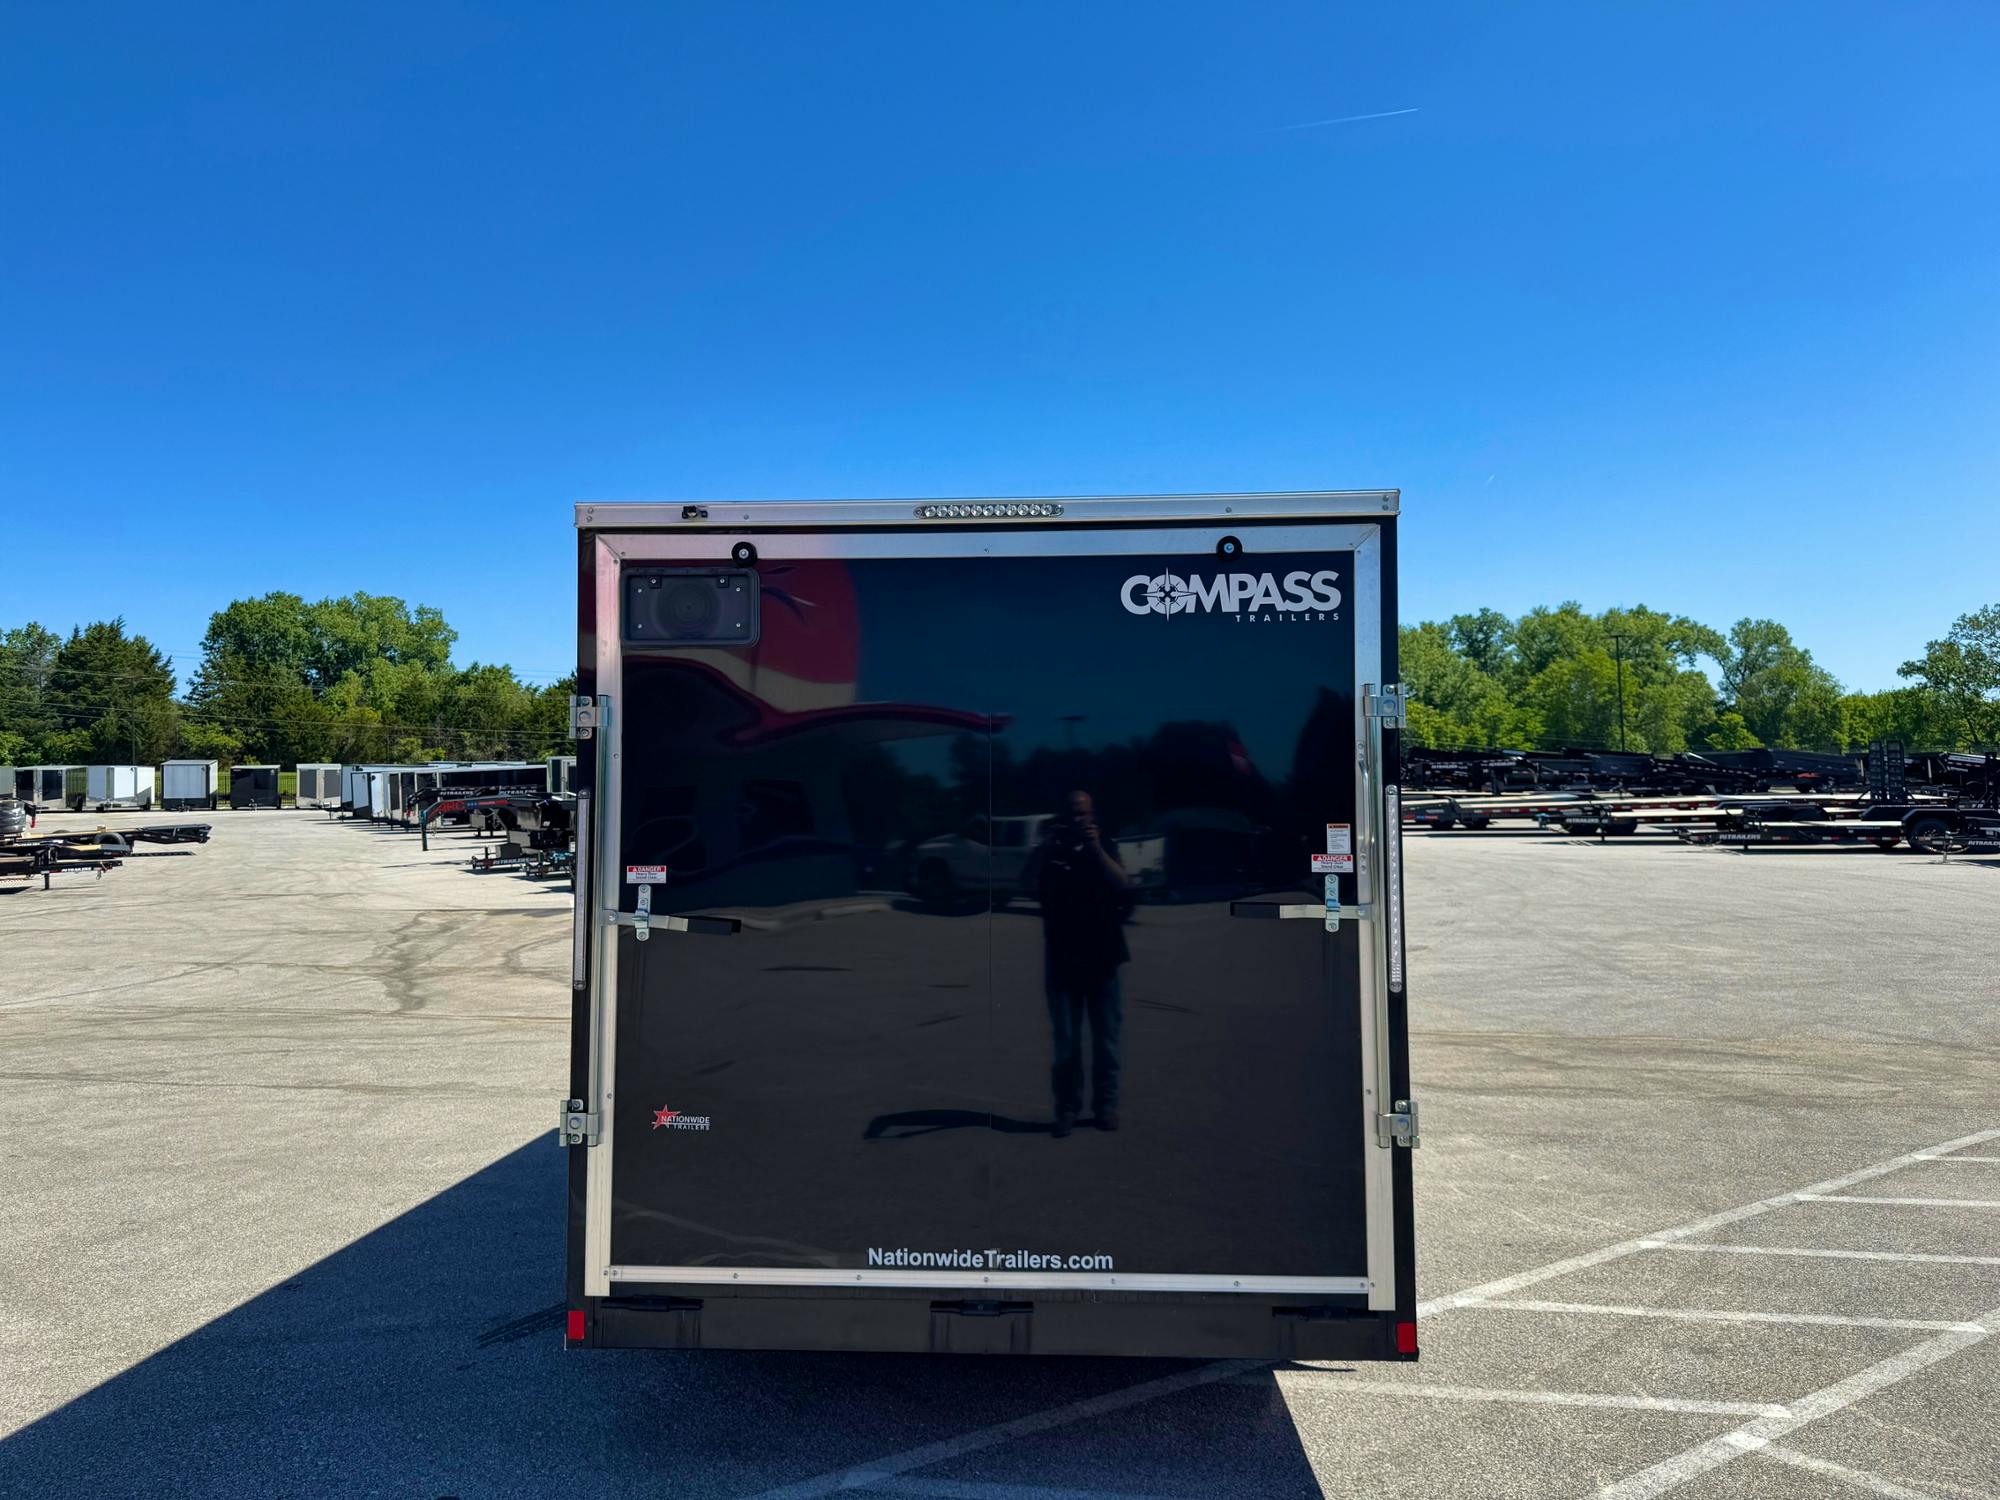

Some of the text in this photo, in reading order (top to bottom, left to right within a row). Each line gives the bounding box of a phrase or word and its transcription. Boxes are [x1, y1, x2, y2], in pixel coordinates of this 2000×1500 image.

[1120, 570, 1342, 616] COMPASS
[1235, 612, 1340, 623] TRAILERS
[661, 1115, 710, 1124] NATIONWIDE
[868, 1247, 1114, 1270] NationwideTrailers.com
